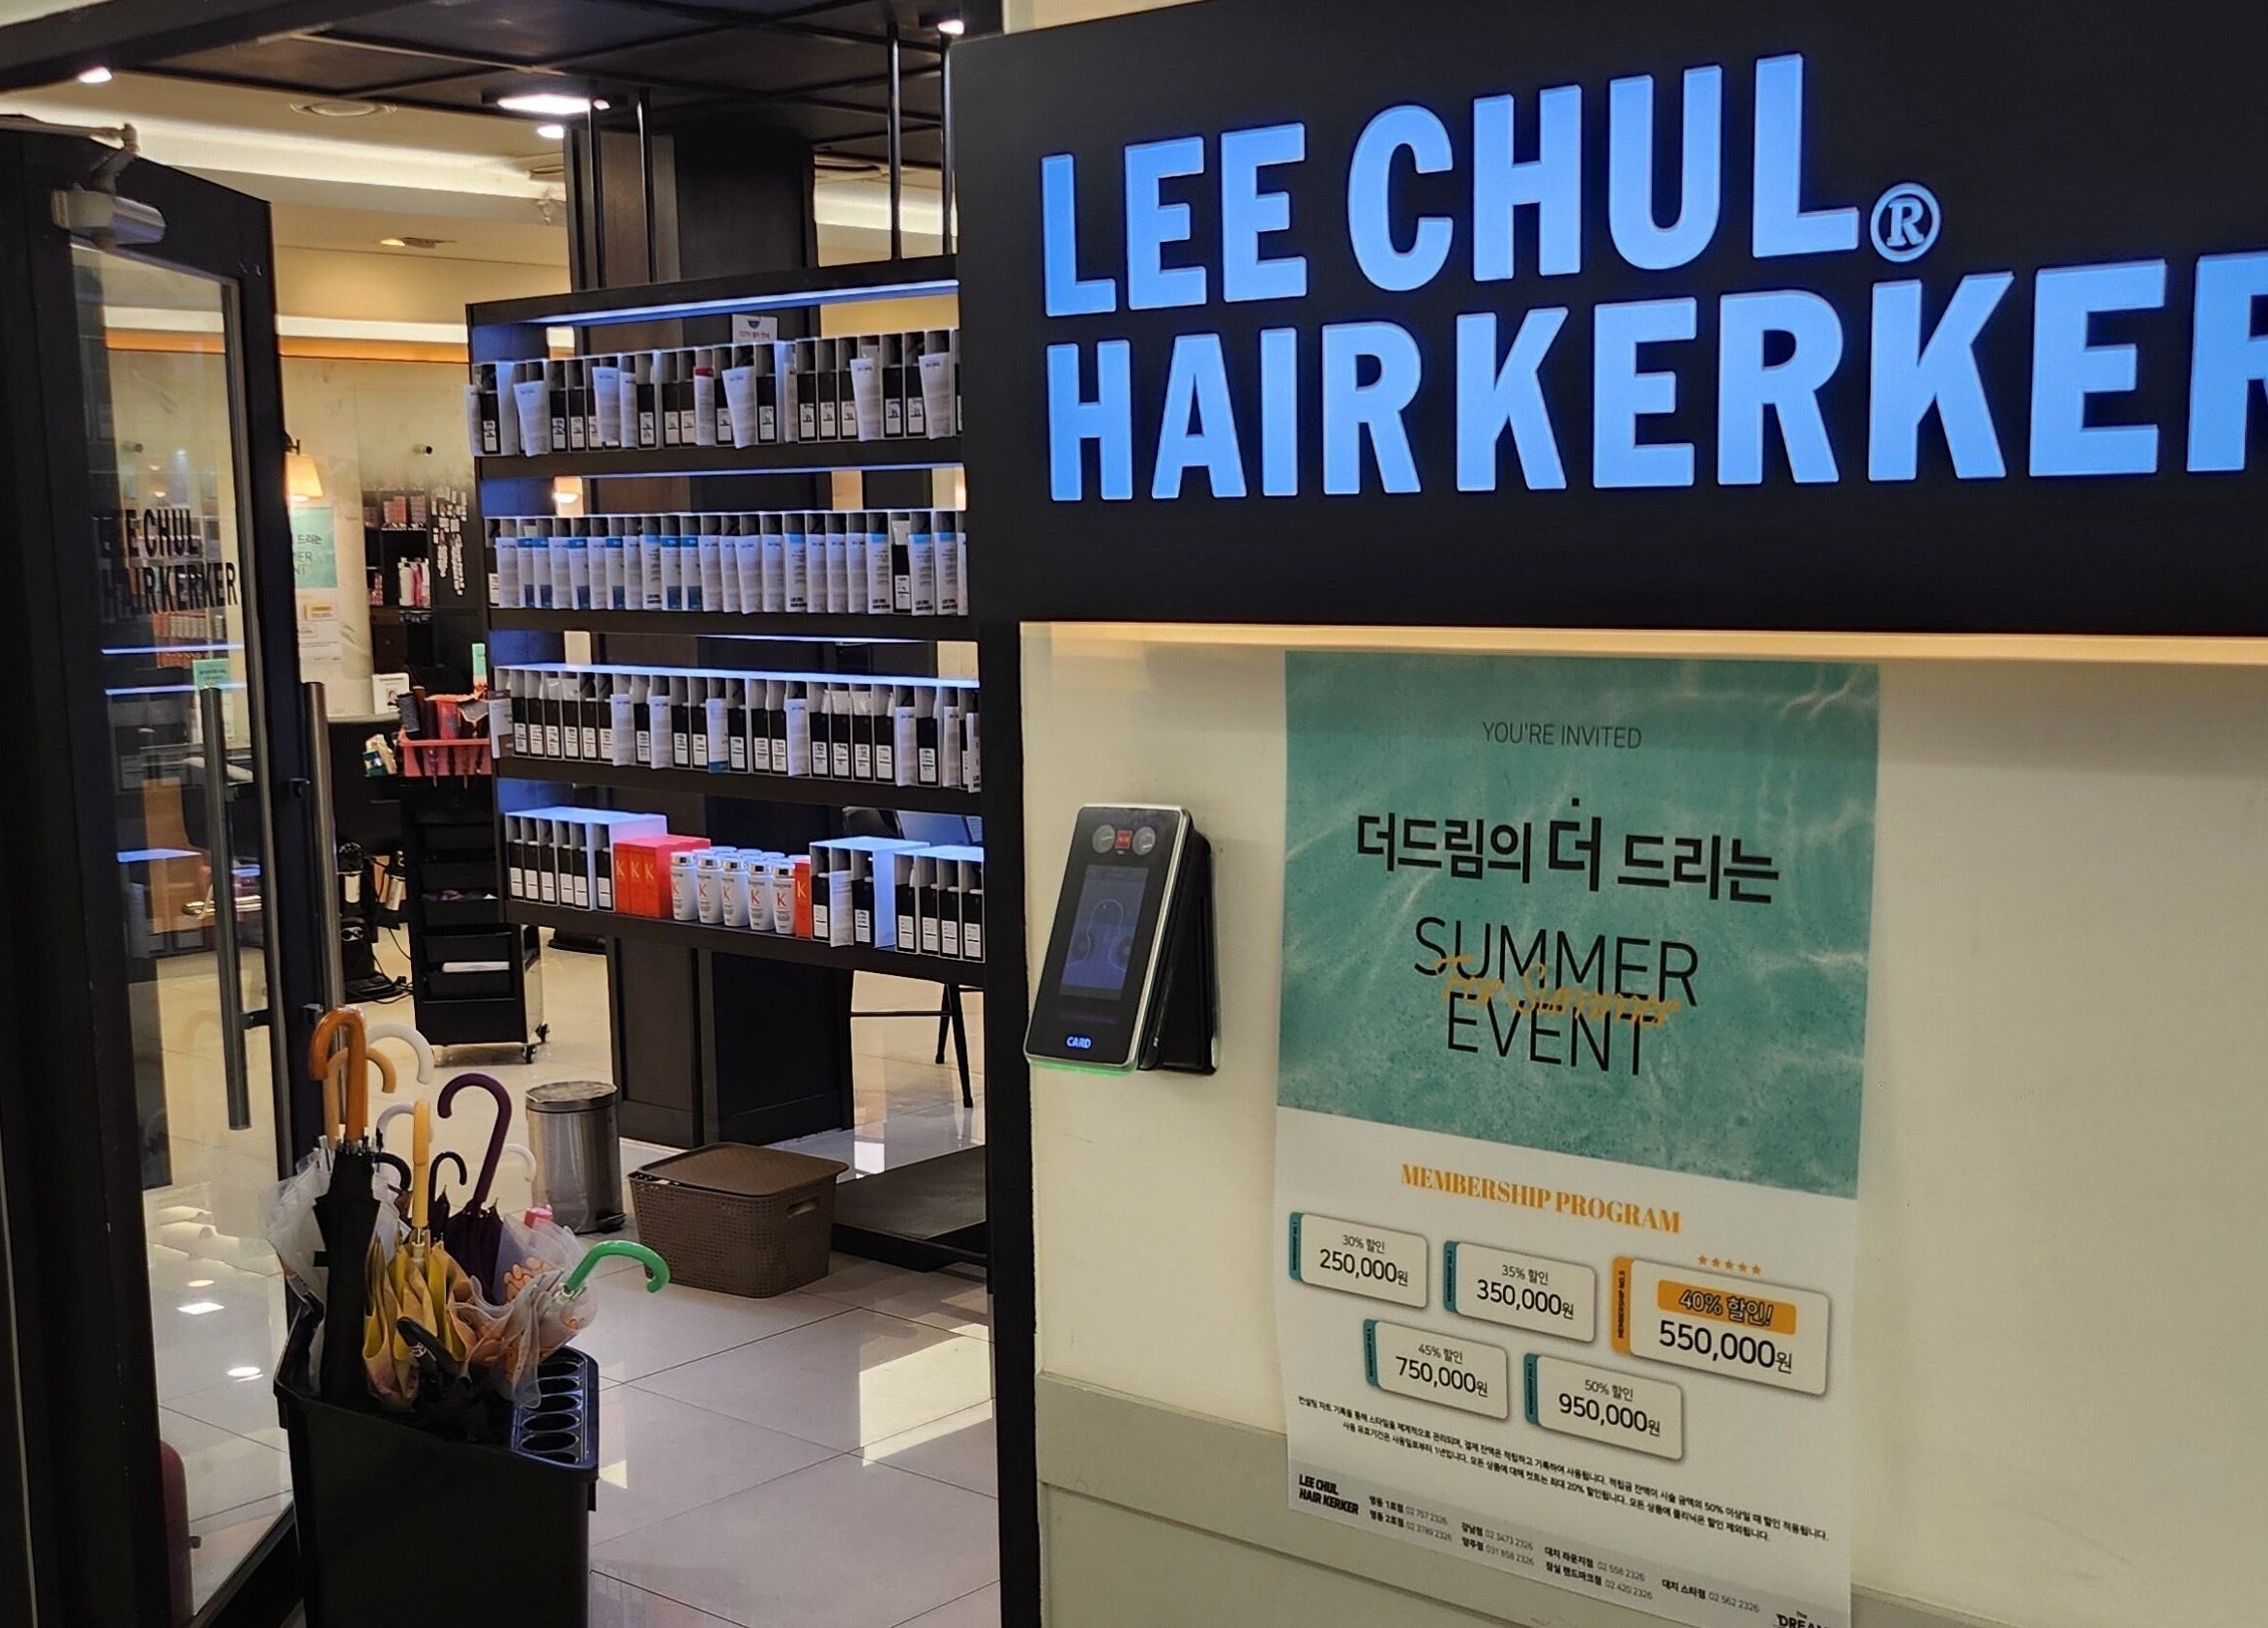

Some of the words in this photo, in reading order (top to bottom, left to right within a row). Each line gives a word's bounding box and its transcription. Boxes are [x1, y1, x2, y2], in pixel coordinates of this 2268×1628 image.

[1042, 122, 1308, 317] LEE
[143, 508, 203, 558] CHUL
[1483, 721, 1555, 746] YOU'RE
[1560, 724, 1643, 750] INVITED
[1357, 812, 1532, 884] 더드림의
[1548, 798, 1602, 892] 더
[1618, 833, 1780, 904] 드리는
[797, 880, 807, 899] K
[1414, 916, 1699, 1007] SUMMER
[1067, 1034, 1092, 1050] CARD
[1448, 991, 1659, 1077] EVENT
[1401, 1163, 1551, 1210] MEMBERSHIP
[1554, 1190, 1682, 1234] PROGRAM
[1342, 1234, 1364, 1250] 30%
[1366, 1237, 1386, 1255] 할인
[1319, 1248, 1409, 1288] 250,000원
[1502, 1264, 1525, 1280] 35%
[1528, 1269, 1549, 1286] 할인
[1477, 1279, 1575, 1320] 350,000원
[1679, 1288, 1723, 1317] 40%
[1725, 1295, 1775, 1328] 할인!
[1418, 1344, 1441, 1359] 45%
[1443, 1348, 1463, 1365] 할인
[1659, 1319, 1793, 1375] 550,000원
[1396, 1356, 1488, 1398] 750,000원
[1584, 1379, 1609, 1396] 50%
[1611, 1384, 1635, 1403] 할인
[1559, 1393, 1662, 1437] 950,000원
[1299, 1473, 1316, 1489] LEE
[1315, 1479, 1340, 1495] CHUL
[1567, 1482, 1585, 1495] 20%
[1299, 1488, 1322, 1505] HAIR
[1323, 1495, 1359, 1516] KERKER
[1704, 1501, 1723, 1515] 50%
[1485, 1528, 1494, 1539] 02
[1598, 1560, 1608, 1570] 02
[1605, 1578, 1615, 1588] 02
[1633, 1585, 1654, 1600] 2326
[1708, 1592, 1719, 1603] 02
[1738, 1599, 1760, 1613] 2326
